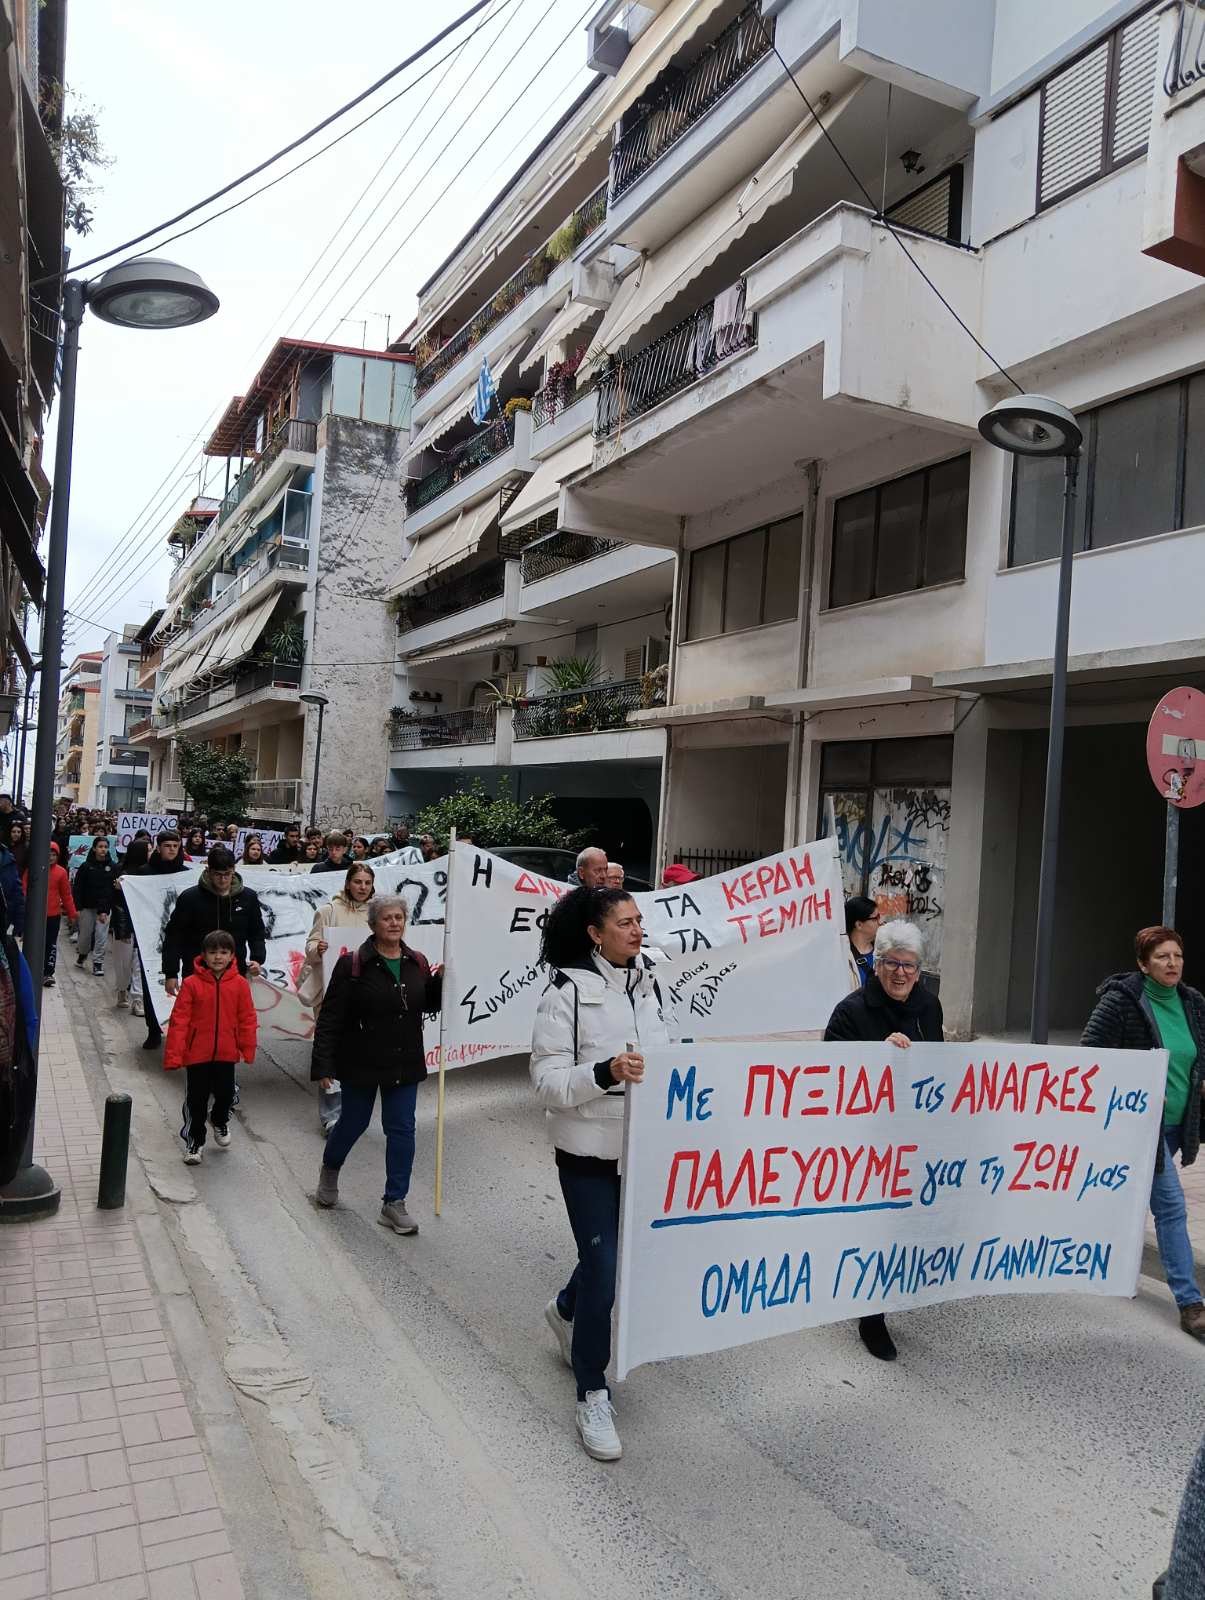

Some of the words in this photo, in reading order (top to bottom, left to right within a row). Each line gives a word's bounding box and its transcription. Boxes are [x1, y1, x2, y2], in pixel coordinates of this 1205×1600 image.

[472, 854, 492, 888] Η
[655, 893, 701, 918] ΤΑ
[722, 853, 816, 910] ΚΕΡΔΗ
[668, 928, 712, 954] ΤΑ
[727, 888, 832, 944] ΤΕΜΠΗ
[666, 1065, 714, 1121] Με
[744, 1064, 895, 1118] ΠΥΞΙΔΑ
[951, 1061, 1100, 1114] ΑΝΑΓΚΕΣ
[1103, 1086, 1148, 1130] μας
[663, 1144, 918, 1213] ΠΑΛΕΥΟΥΜΕ
[920, 1158, 968, 1206] για
[1076, 1162, 1129, 1201] μας
[701, 1252, 811, 1318] ΟΜΑΔΑ
[832, 1243, 965, 1300] ΓΥΝΑΙΚΩΝ
[970, 1235, 1112, 1281] ΓΙΑΝΝΙΤΣΩΝ
